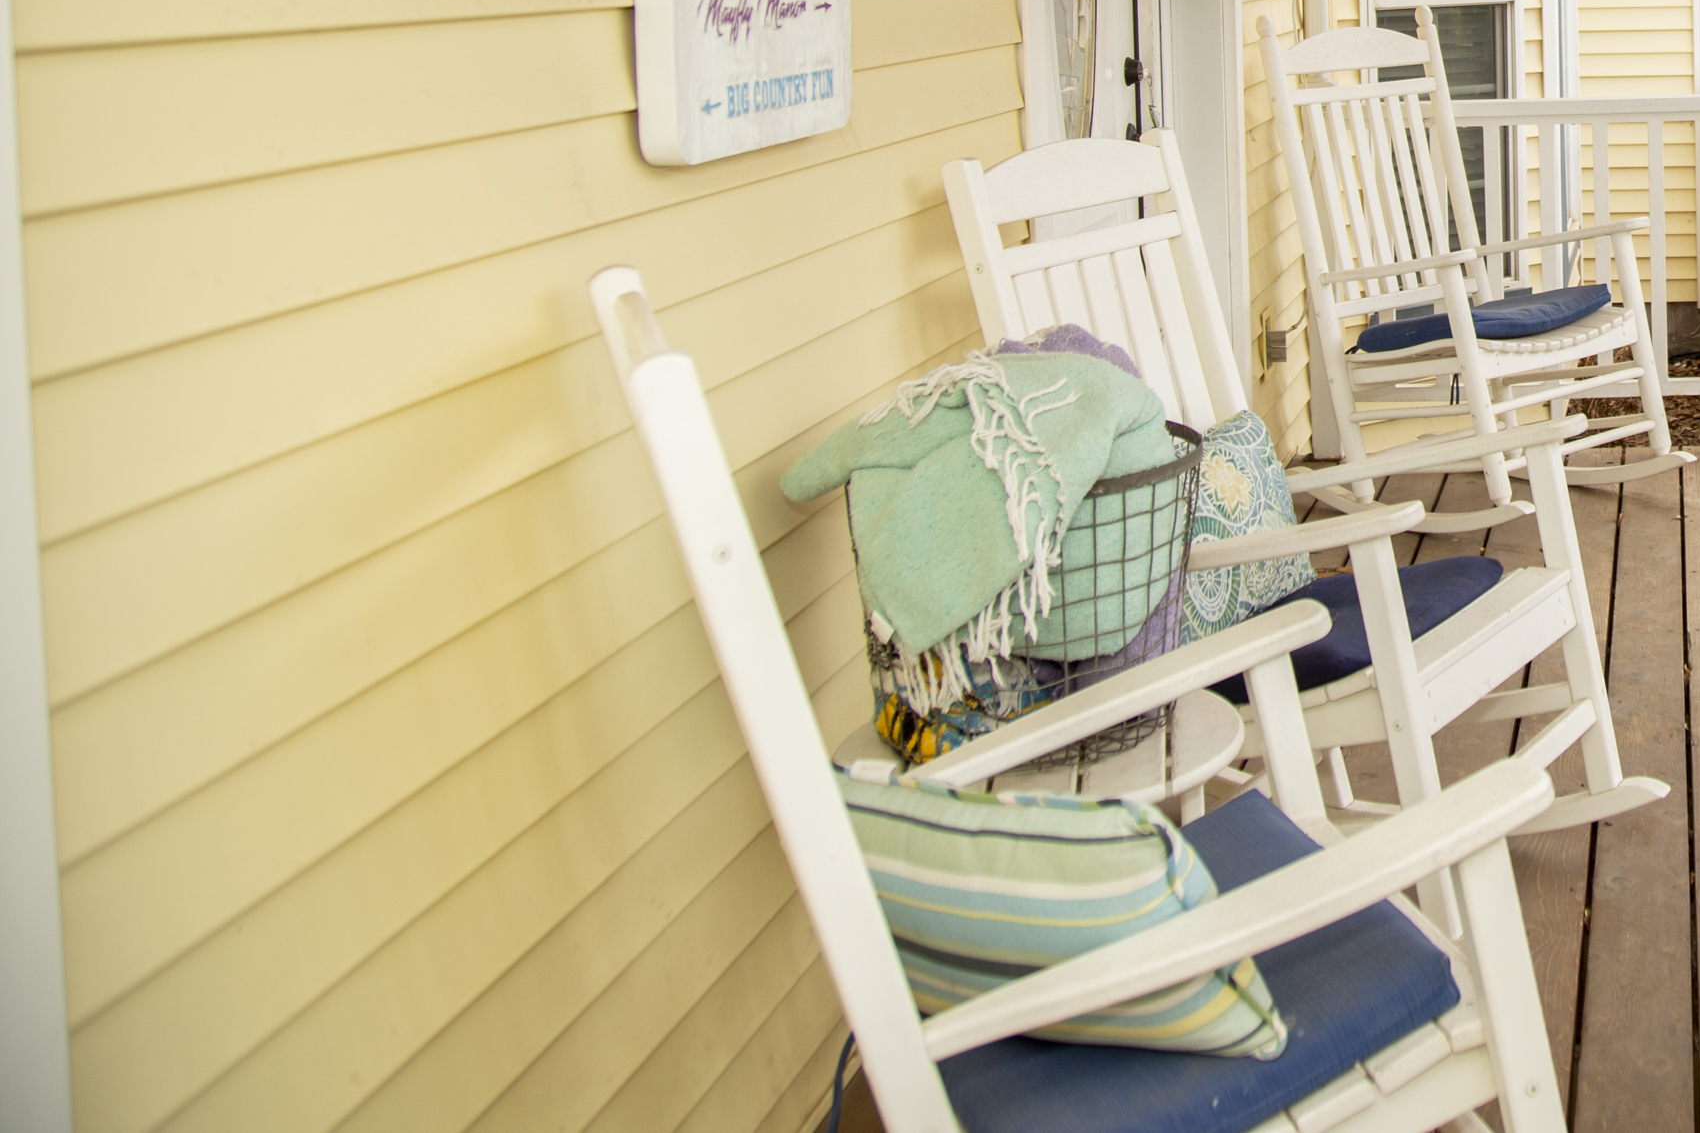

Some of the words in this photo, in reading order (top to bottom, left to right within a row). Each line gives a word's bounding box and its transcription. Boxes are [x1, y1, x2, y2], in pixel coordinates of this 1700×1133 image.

[727, 82, 749, 118] BIG
[753, 73, 808, 113] COUNTRY
[811, 69, 833, 101] FUN
